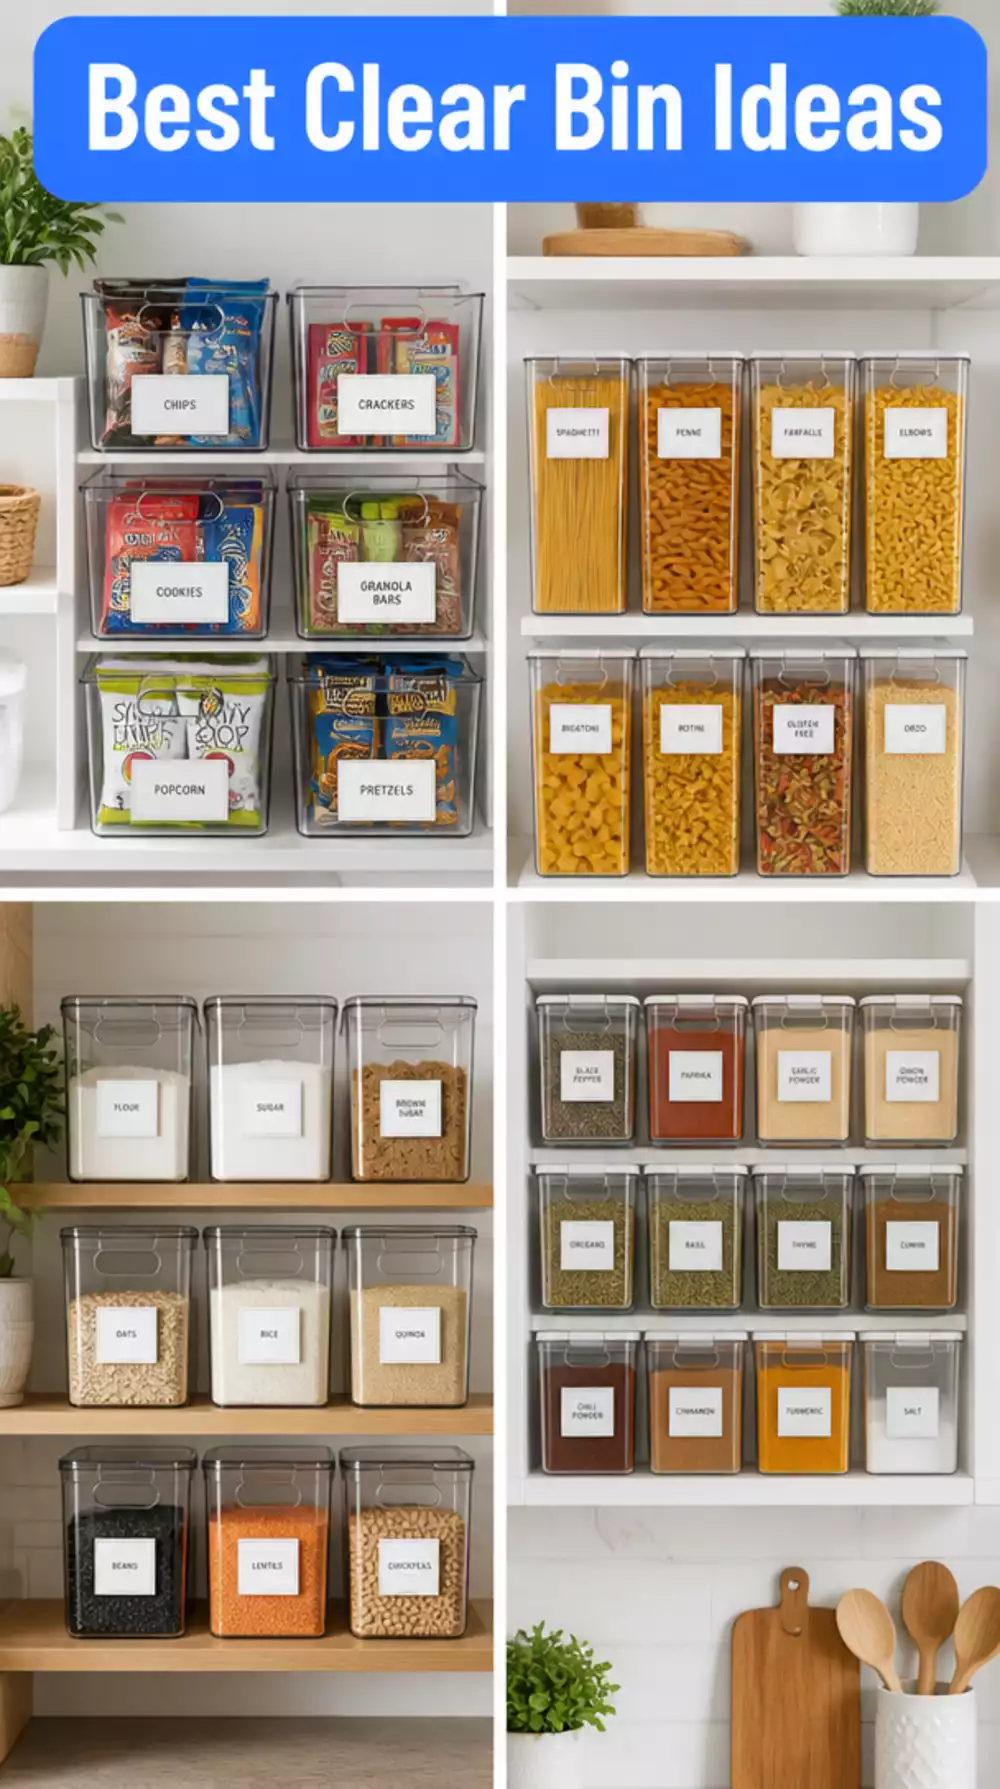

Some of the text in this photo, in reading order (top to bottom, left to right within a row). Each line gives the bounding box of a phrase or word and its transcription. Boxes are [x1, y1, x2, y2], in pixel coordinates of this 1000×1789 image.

[163, 398, 197, 411] CHIPS
[357, 398, 416, 411] CRACKERS
[555, 427, 601, 437] SPAGHETTI
[675, 427, 702, 438] PENNE
[898, 428, 933, 438] ELBOWS
[359, 580, 413, 593] GRANOLA
[155, 586, 204, 599] COOKIES
[372, 595, 402, 606] BARS
[153, 783, 206, 796] POPCORN
[359, 783, 414, 797] PRETZELS
[680, 1071, 712, 1080] PAPRIKA
[113, 1102, 140, 1113] FLOUR
[255, 1102, 285, 1113] SUGAR
[395, 1098, 427, 1109] BROWN
[398, 1108, 424, 1118] SUGAR
[569, 1240, 606, 1249] OREGANO
[684, 1240, 706, 1250] BASIL
[115, 1329, 138, 1339] OATS
[259, 1329, 279, 1339] RICE
[903, 1406, 923, 1416] SALT
[111, 1561, 139, 1571] BEANS
[251, 1561, 284, 1571] LENTILS
